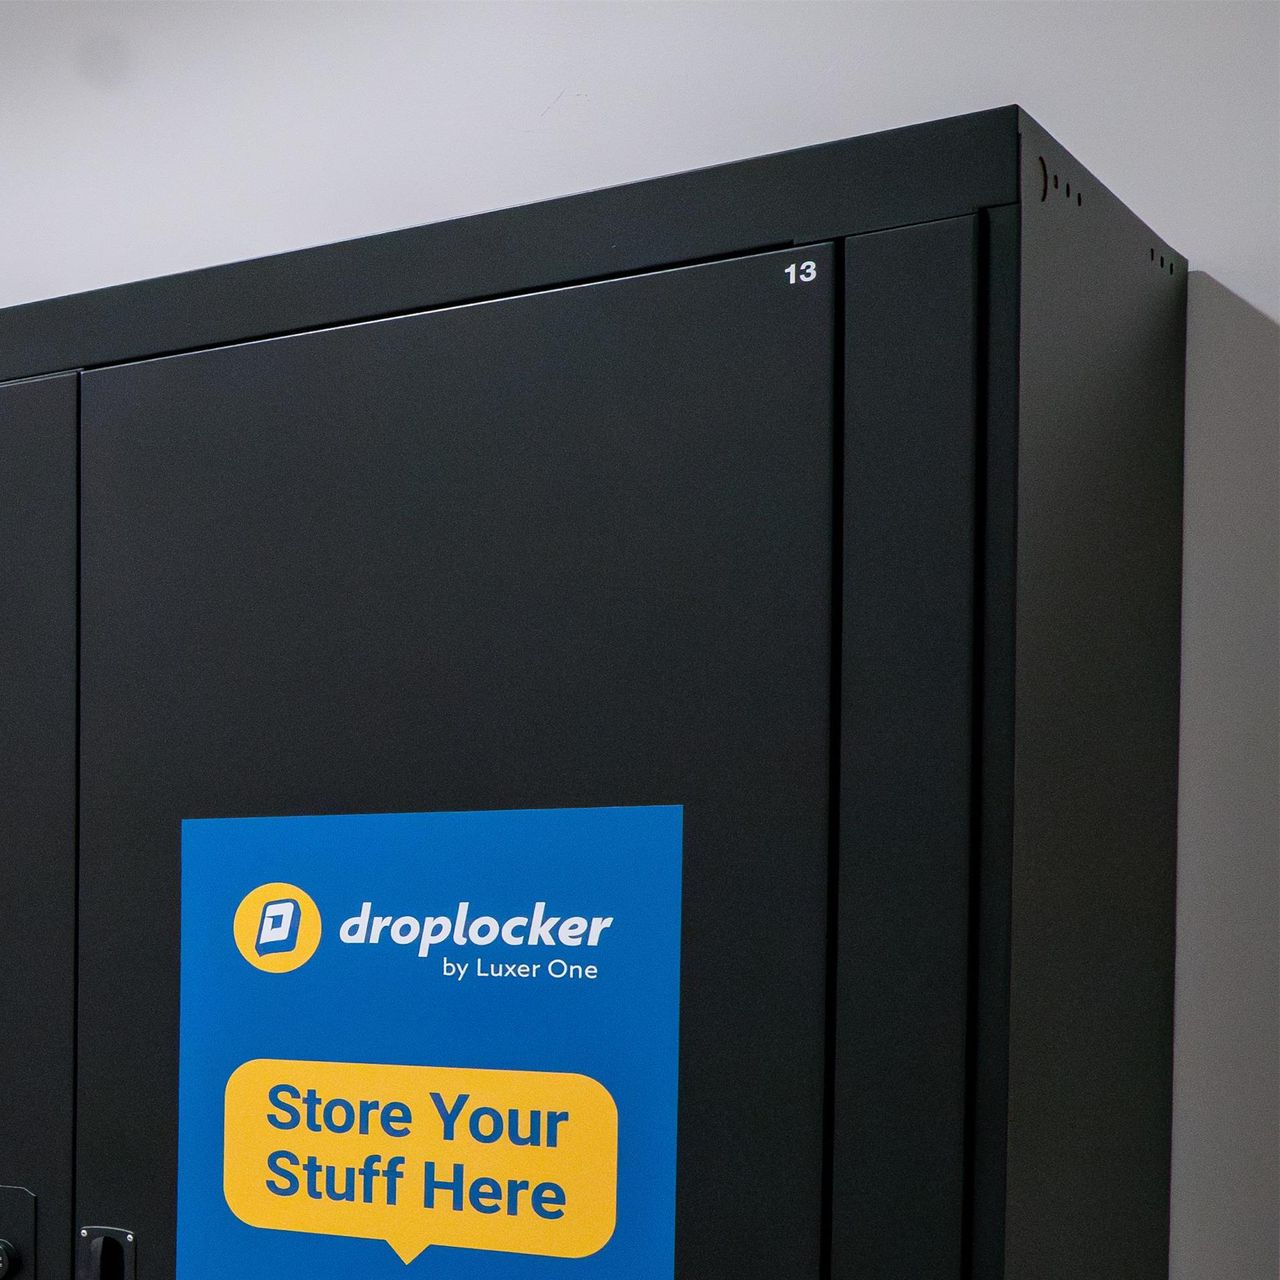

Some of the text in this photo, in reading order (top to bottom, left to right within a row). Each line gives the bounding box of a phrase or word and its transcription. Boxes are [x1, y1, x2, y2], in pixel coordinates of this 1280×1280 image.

[784, 261, 817, 285] 13
[339, 901, 614, 958] droplocker
[442, 957, 599, 981] by Luxer One
[266, 1083, 569, 1148] Store Your
[265, 1150, 567, 1220] Stuff Here
